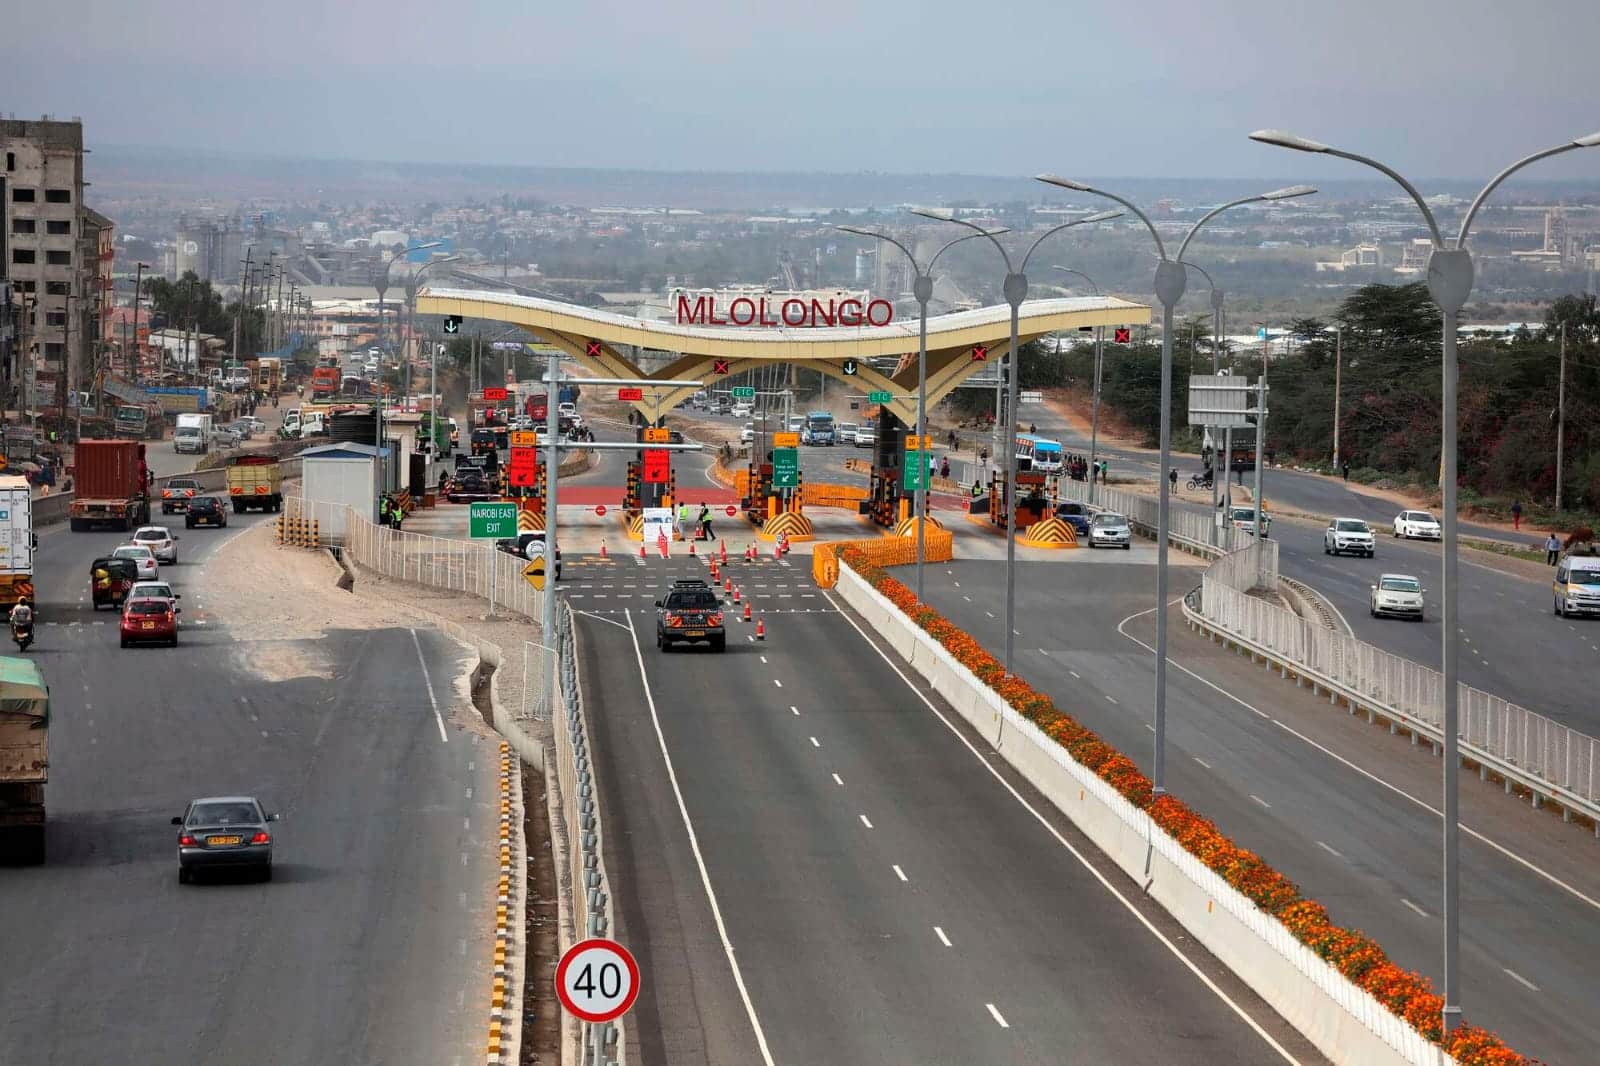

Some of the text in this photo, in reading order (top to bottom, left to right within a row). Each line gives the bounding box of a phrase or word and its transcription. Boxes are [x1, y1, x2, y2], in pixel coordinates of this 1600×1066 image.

[678, 296, 893, 327] MLOLONGO
[515, 433, 521, 443] 5
[471, 508, 515, 519] NAIROBI EAST
[486, 523, 501, 533] EXIT
[573, 962, 621, 999] 40
